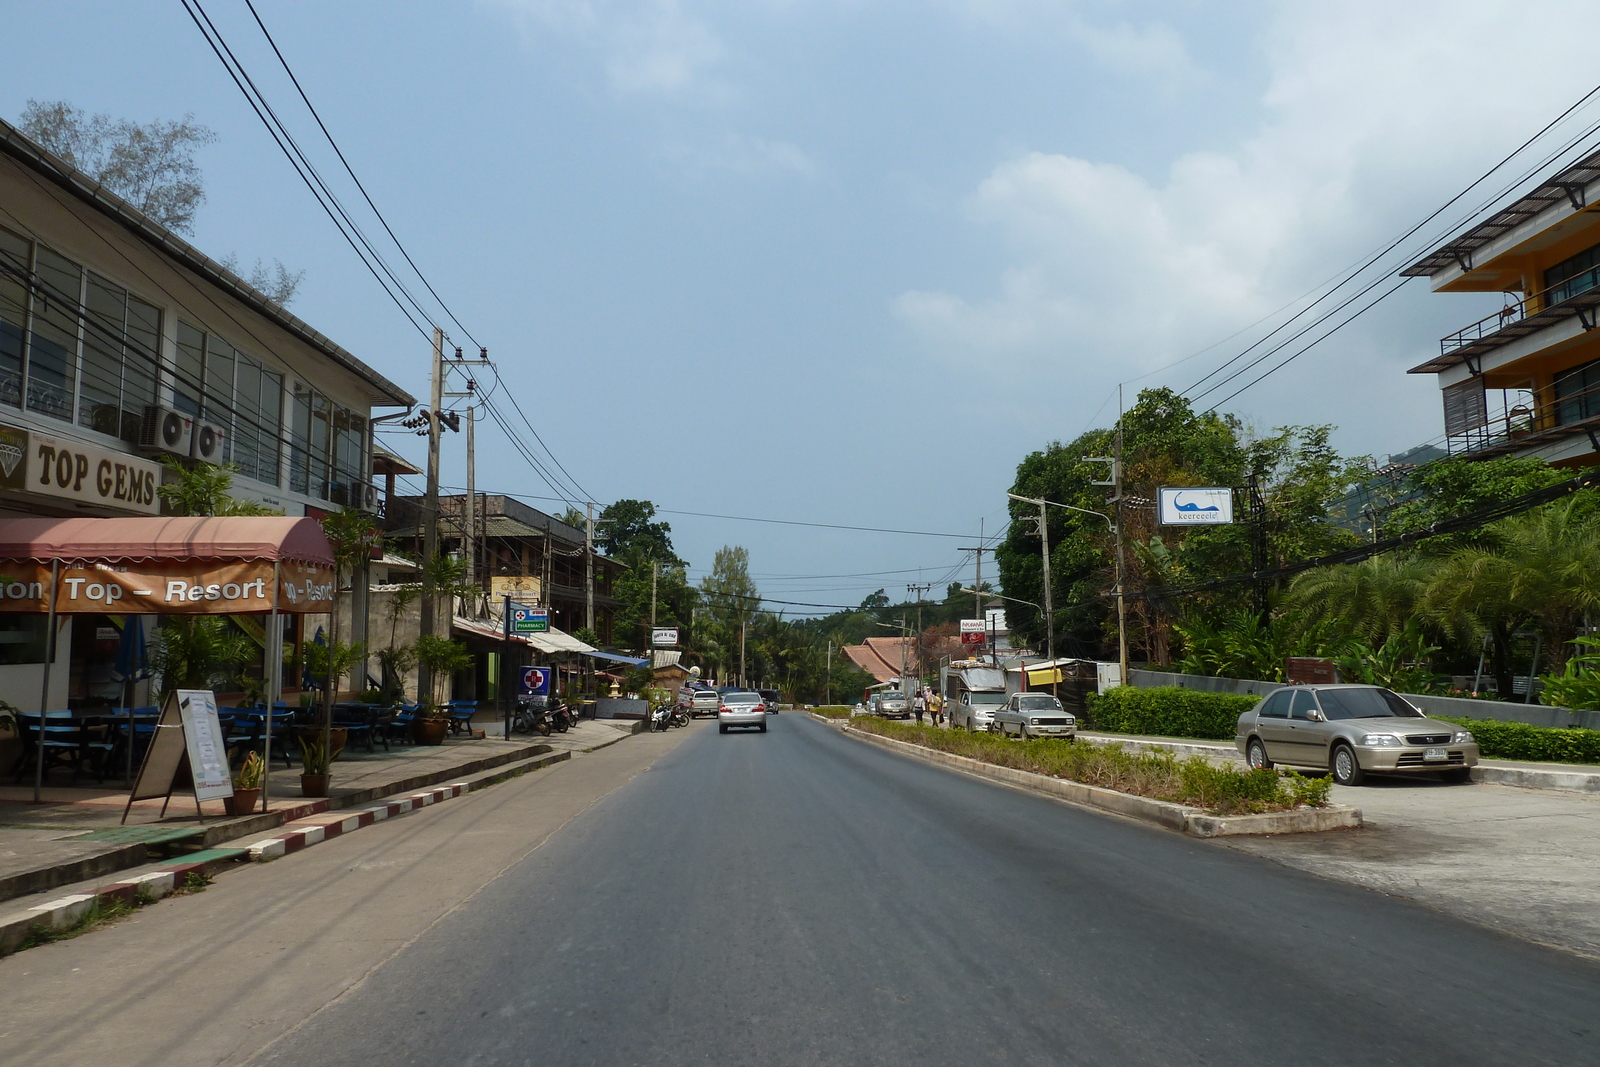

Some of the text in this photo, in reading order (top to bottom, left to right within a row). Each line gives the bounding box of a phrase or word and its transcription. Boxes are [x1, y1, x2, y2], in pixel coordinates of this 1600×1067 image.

[38, 443, 155, 506] TOP GEMS
[64, 577, 123, 604] Top
[164, 577, 266, 602] Resort
[305, 578, 333, 601] Resort
